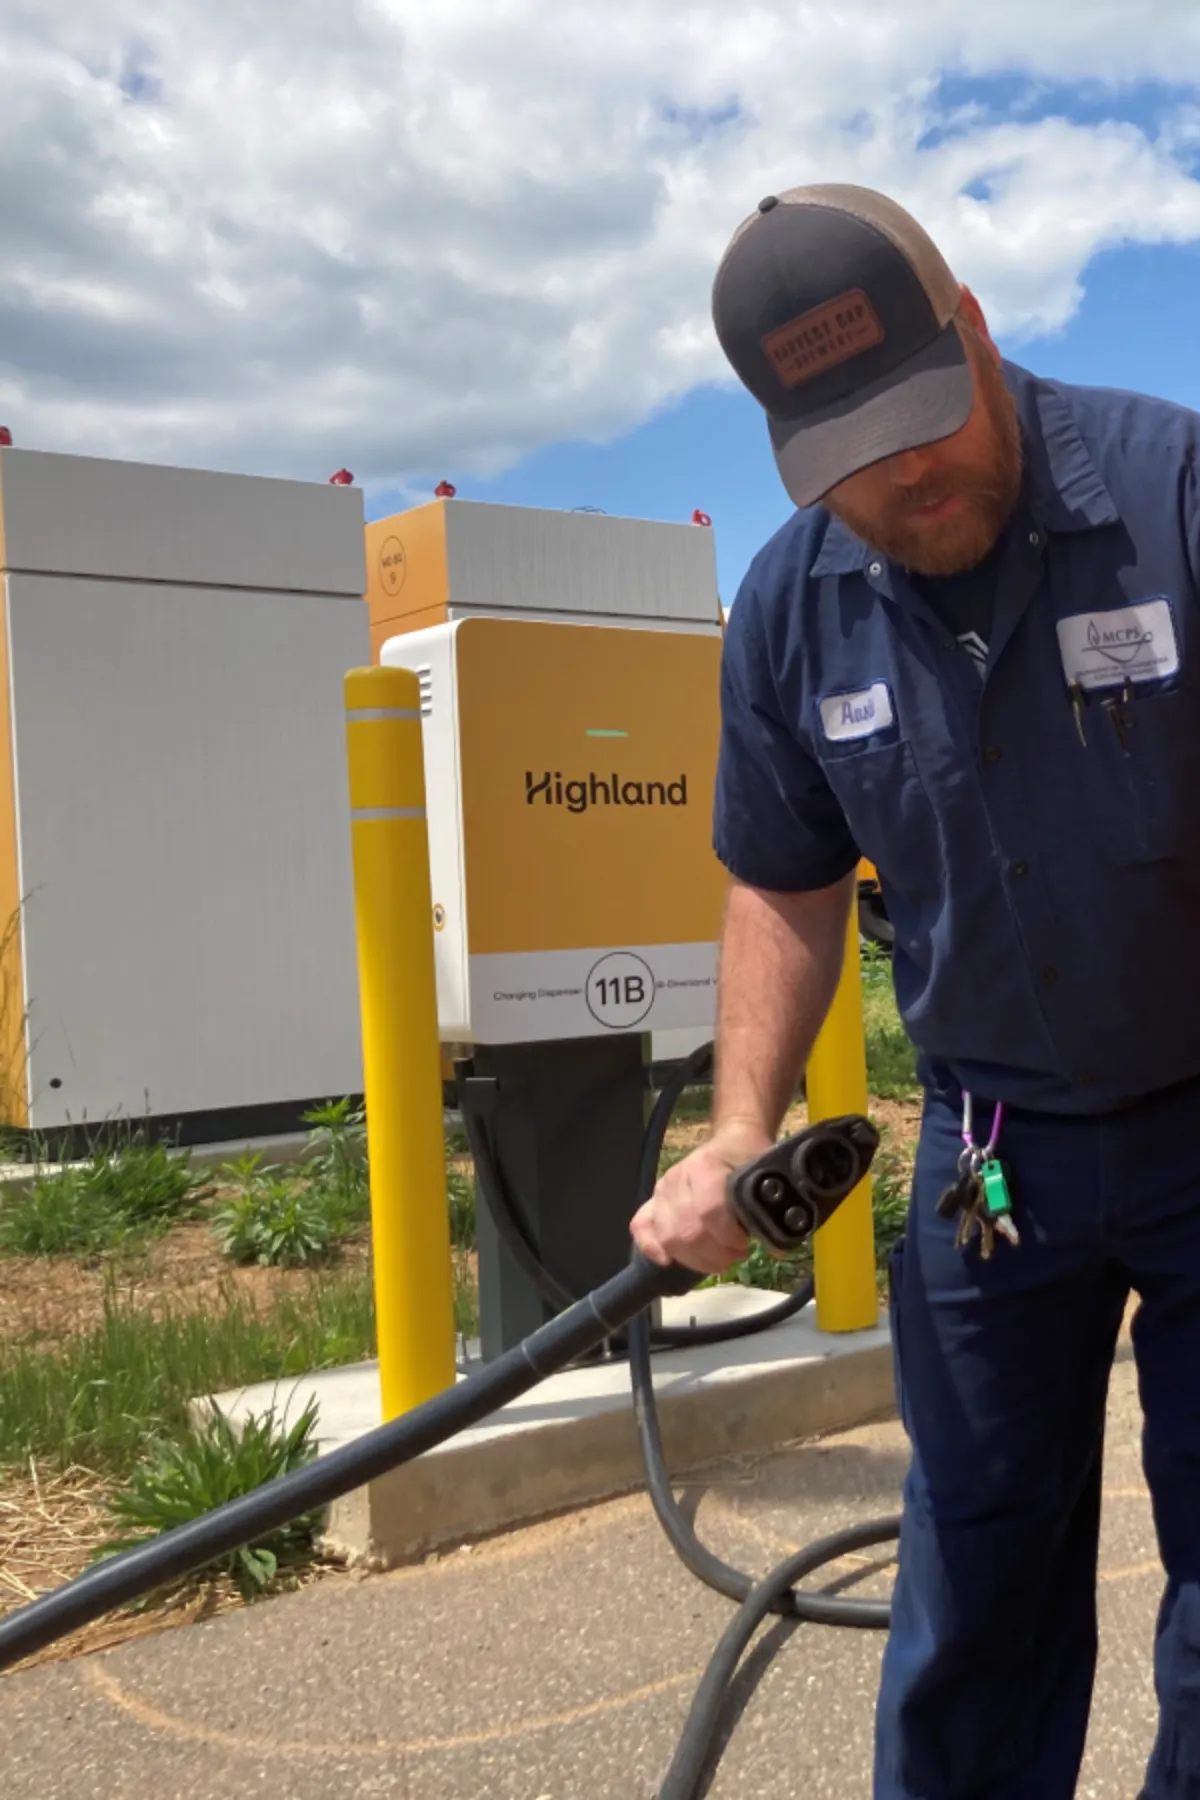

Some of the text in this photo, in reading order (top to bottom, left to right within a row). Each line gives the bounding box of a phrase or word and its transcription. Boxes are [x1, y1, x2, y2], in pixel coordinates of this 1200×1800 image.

[525, 771, 688, 814] Highland
[493, 990, 536, 1002] Charging
[595, 975, 645, 1006] 11B
